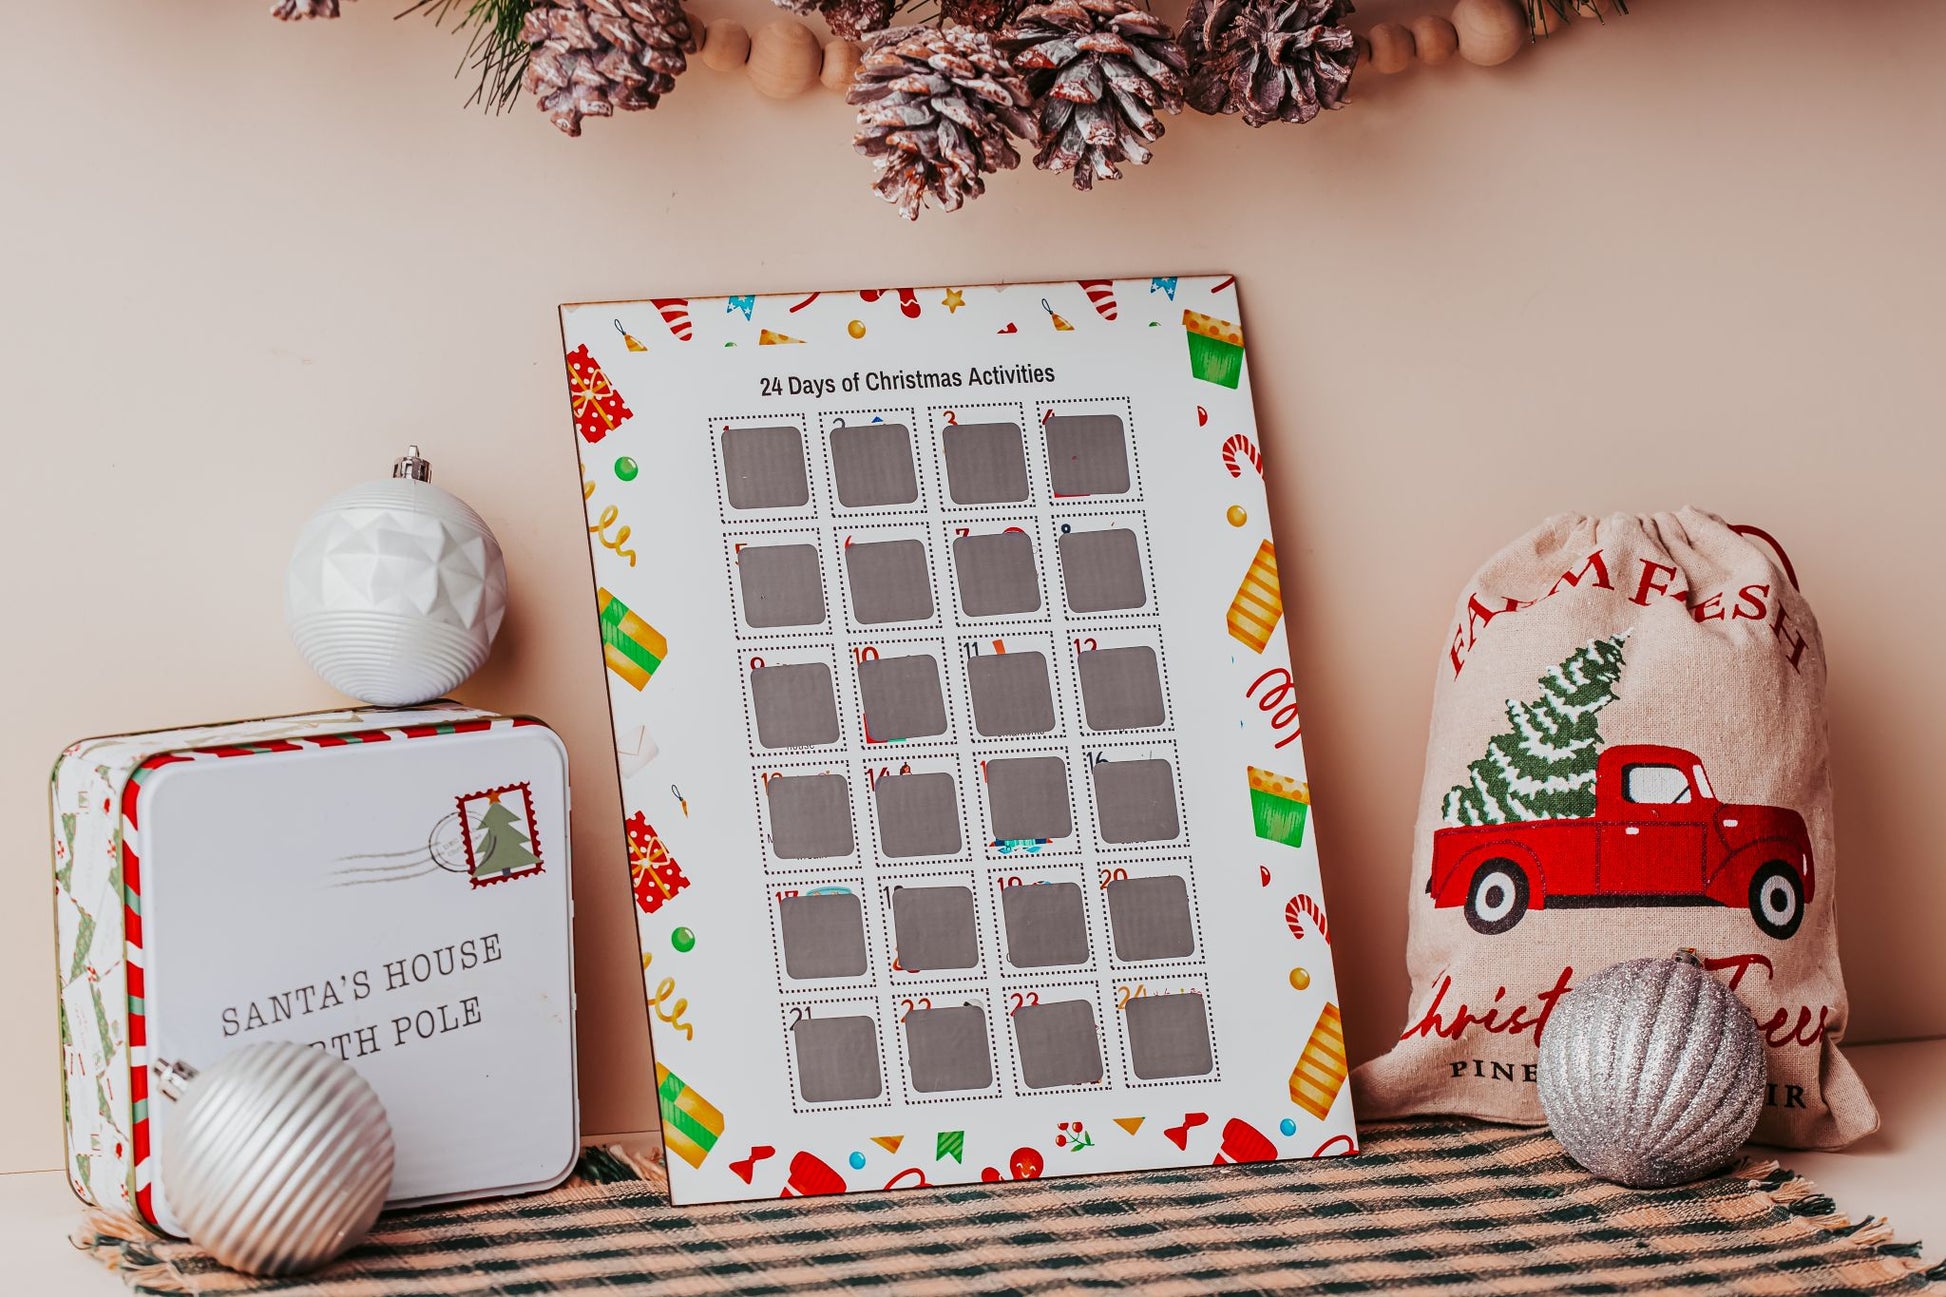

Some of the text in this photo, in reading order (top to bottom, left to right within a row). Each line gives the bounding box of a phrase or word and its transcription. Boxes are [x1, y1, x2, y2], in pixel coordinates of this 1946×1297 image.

[760, 363, 1056, 398] 24 Days of Christmas Activities
[221, 933, 502, 1037] SANTA'S HOUSE
[391, 996, 482, 1046] POLE
[1450, 1059, 1807, 1109] PINE IR
